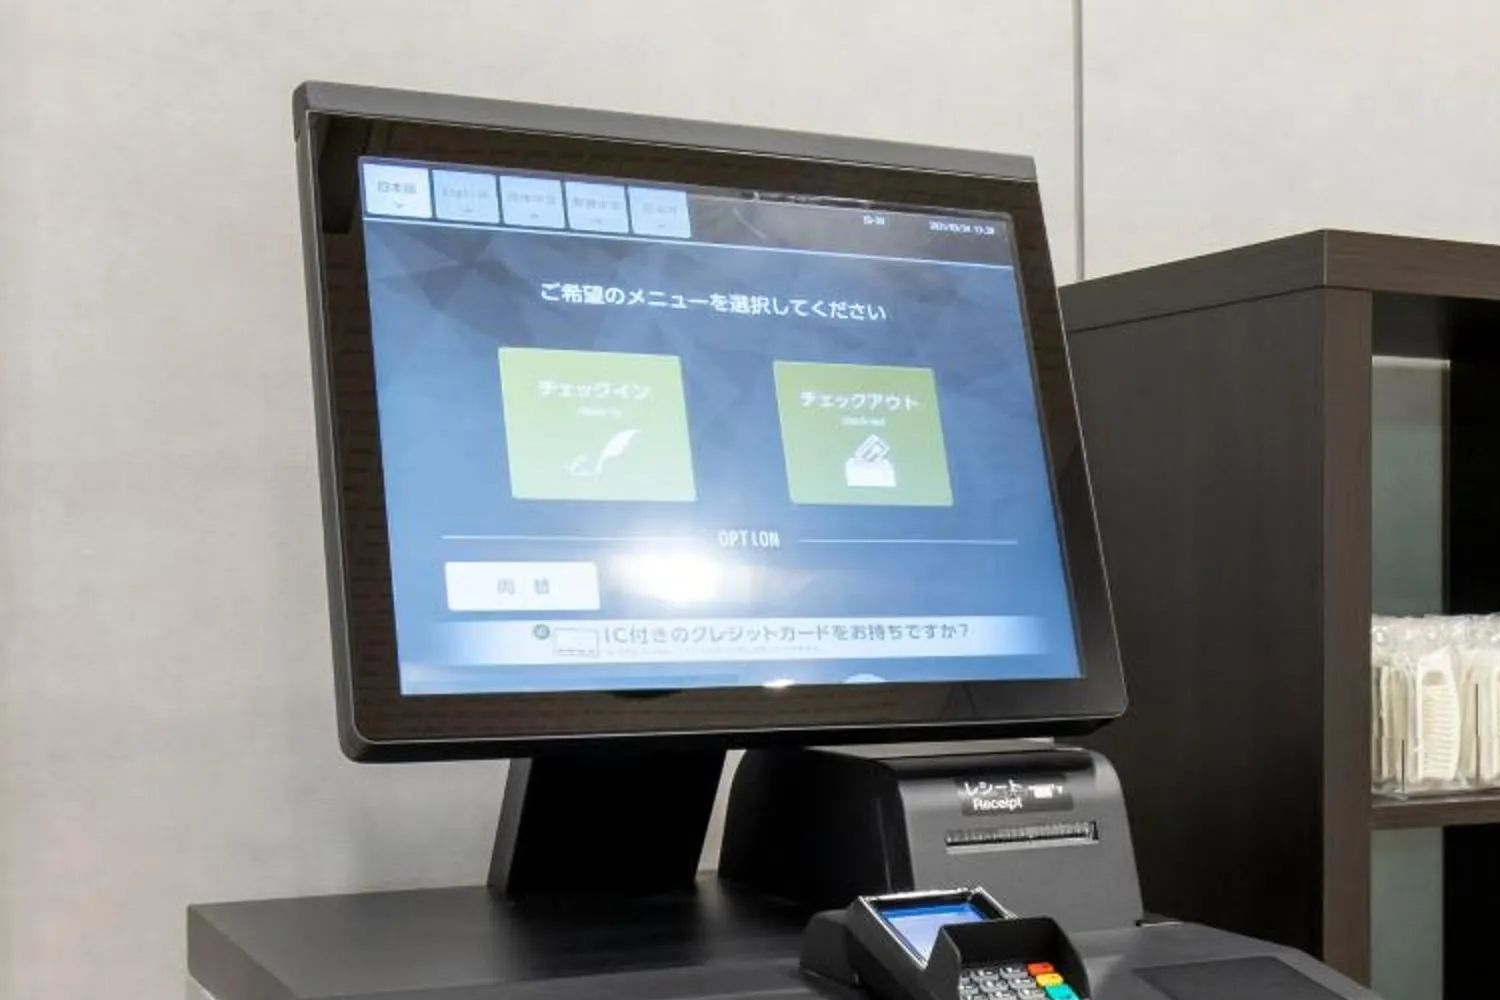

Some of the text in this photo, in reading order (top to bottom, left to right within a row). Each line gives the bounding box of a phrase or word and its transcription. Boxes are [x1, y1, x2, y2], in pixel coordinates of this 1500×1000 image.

[540, 281, 887, 321] ご希望のメニューを選択してください
[537, 379, 652, 401] チェックイン
[800, 390, 920, 412] チェックアウト
[717, 529, 781, 549] OPTION
[972, 796, 1024, 812] Receipt
